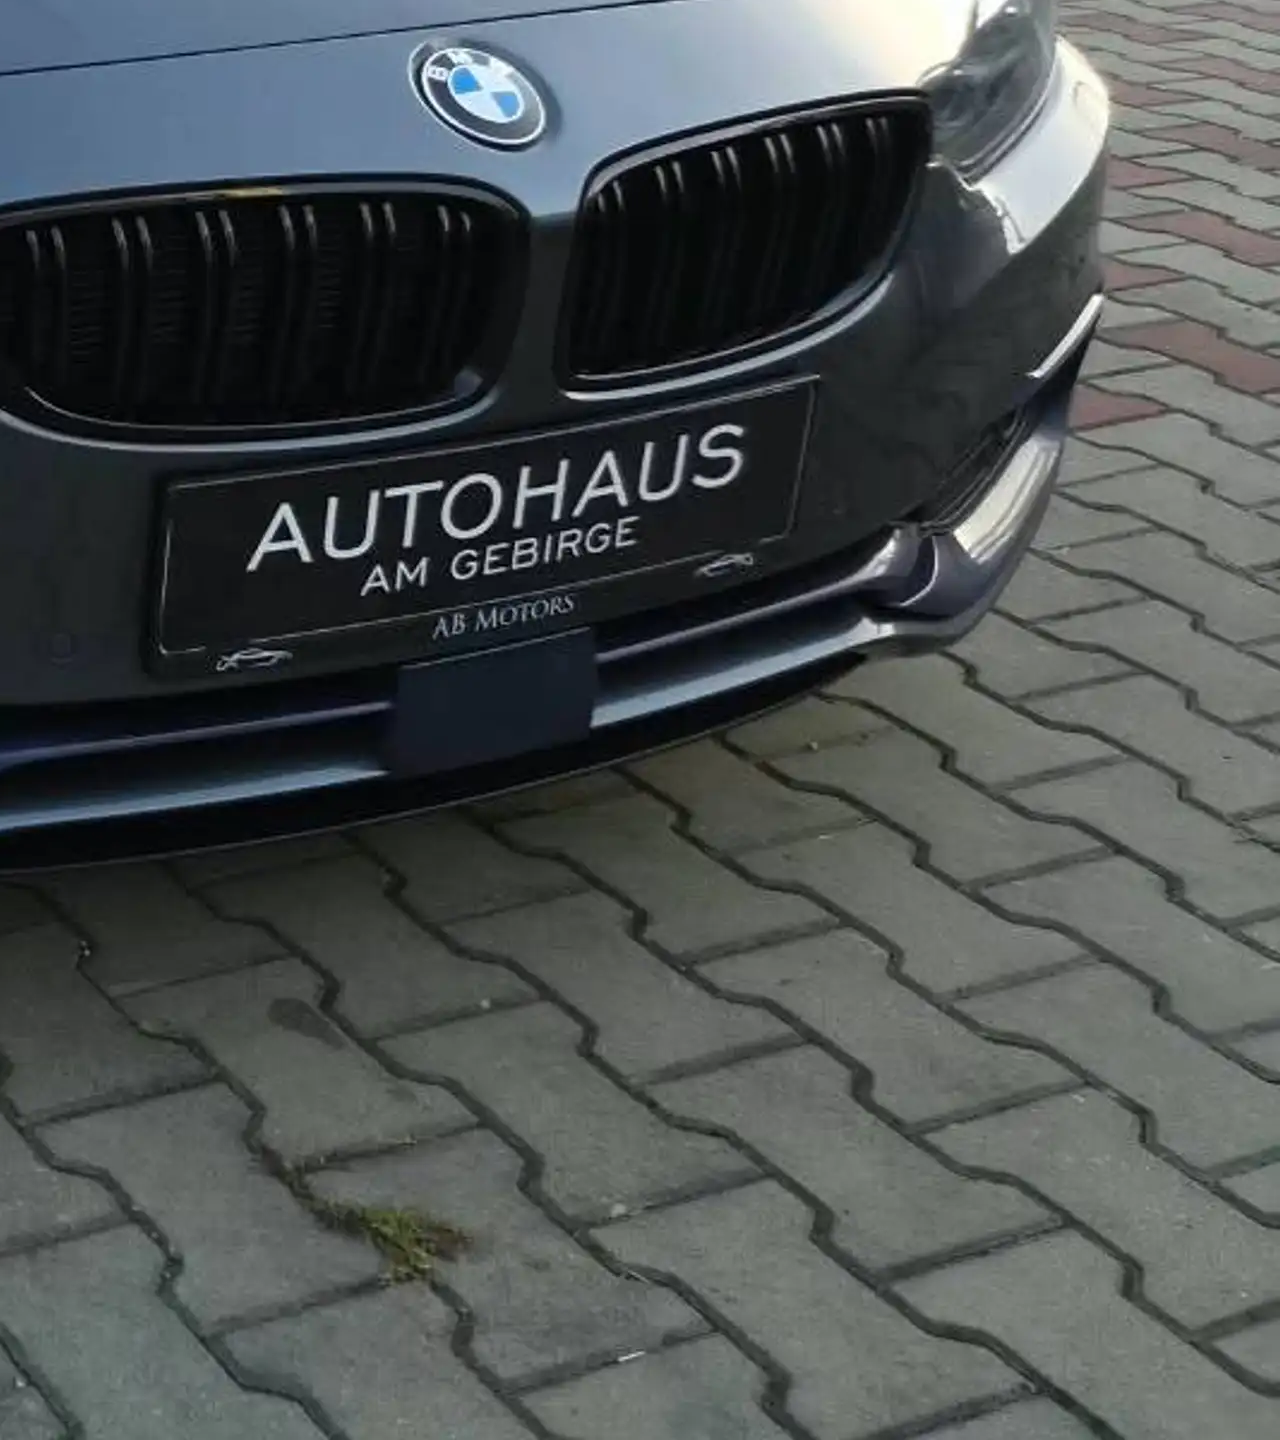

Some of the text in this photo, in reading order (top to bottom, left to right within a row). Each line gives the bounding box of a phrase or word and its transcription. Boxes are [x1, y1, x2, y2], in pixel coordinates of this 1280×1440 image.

[246, 424, 745, 573] AUTOHAUS
[359, 516, 640, 597] AM GEBIRGE
[431, 595, 575, 640] AB MOTORS
